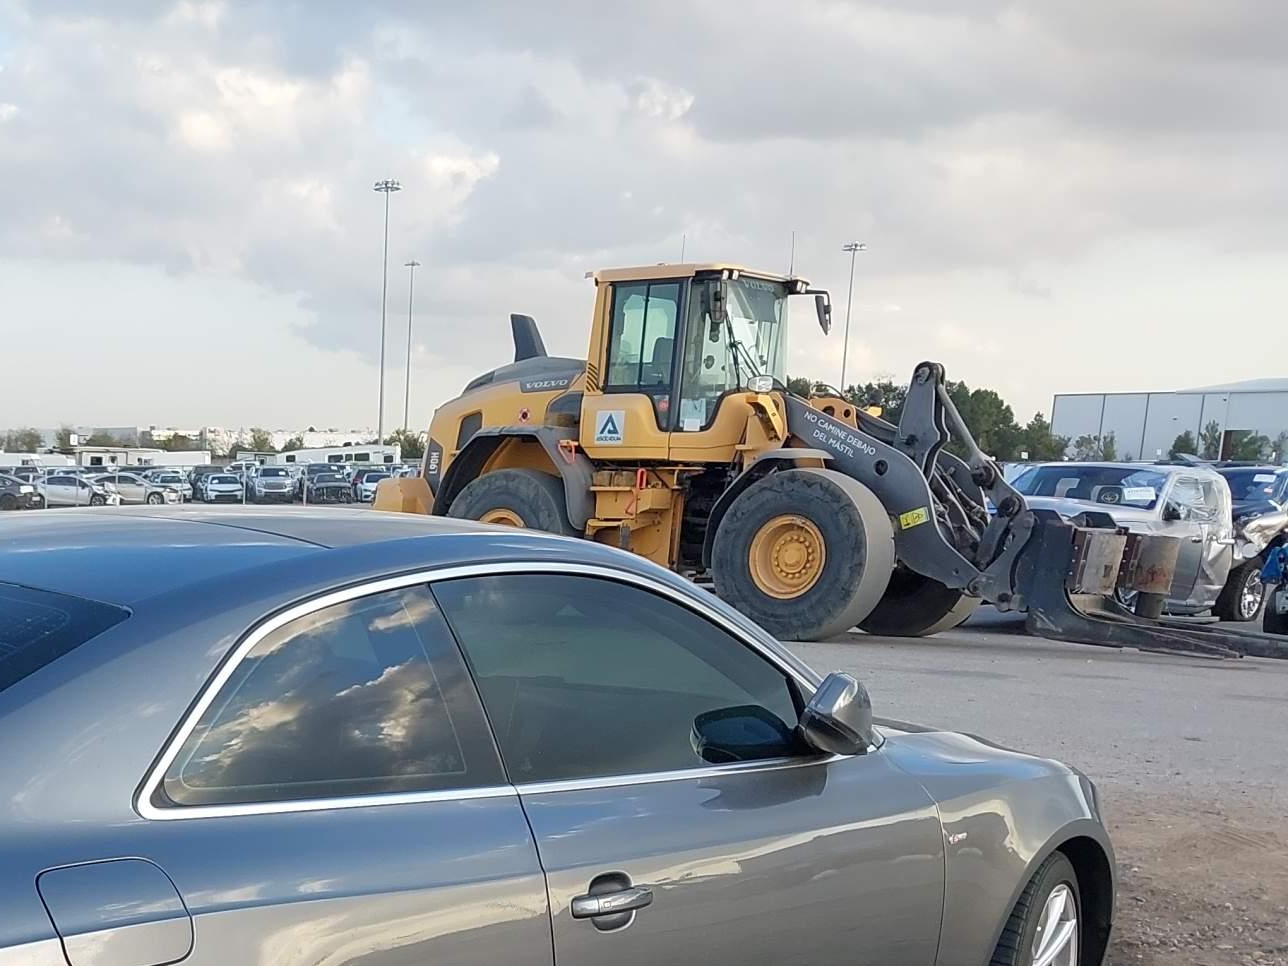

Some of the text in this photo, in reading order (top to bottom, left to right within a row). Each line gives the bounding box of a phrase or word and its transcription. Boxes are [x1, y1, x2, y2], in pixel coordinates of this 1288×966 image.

[526, 380, 569, 389] VOLVO
[804, 411, 876, 456] NO CAMINE DEBAJO
[813, 429, 828, 443] DEL
[428, 452, 440, 474] L90H
